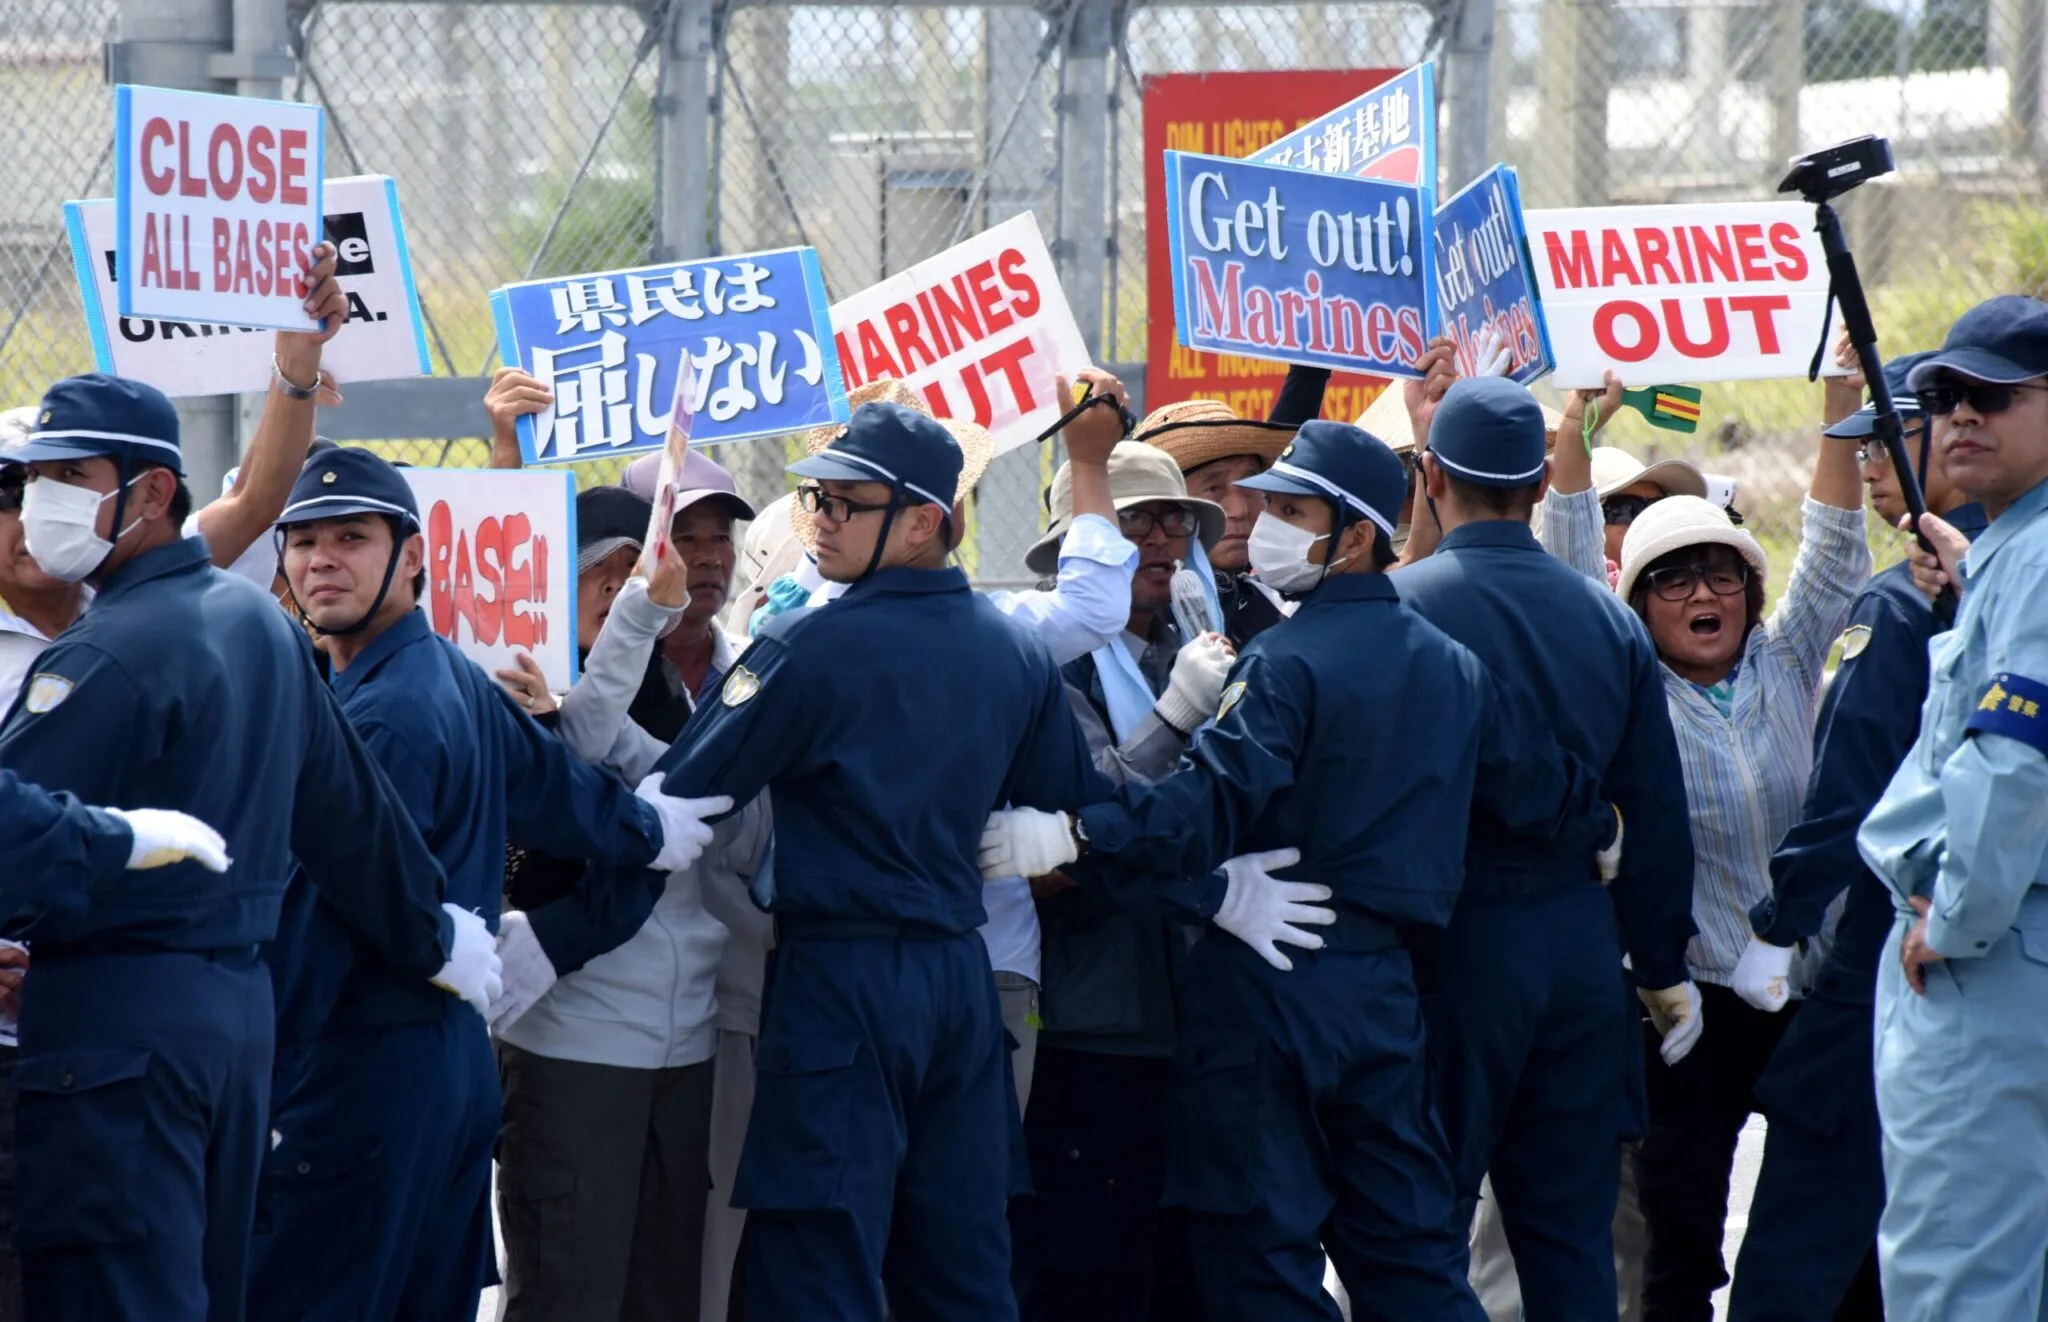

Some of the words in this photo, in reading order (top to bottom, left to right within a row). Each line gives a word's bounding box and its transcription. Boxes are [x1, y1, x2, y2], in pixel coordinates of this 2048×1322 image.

[140, 117, 308, 206] CLOSE
[140, 212, 201, 291] ALL
[212, 217, 310, 300] BASES
[1189, 171, 1288, 260] Get
[1307, 196, 1413, 276] out!
[1472, 183, 1515, 286] out!
[1543, 222, 1809, 289] MARINES
[551, 262, 776, 335] 県民は
[1190, 257, 1425, 366] Marines
[1447, 296, 1538, 377] Mines
[1593, 295, 1791, 362] OUT
[531, 328, 824, 459] 屈しない
[922, 336, 1037, 431] UT
